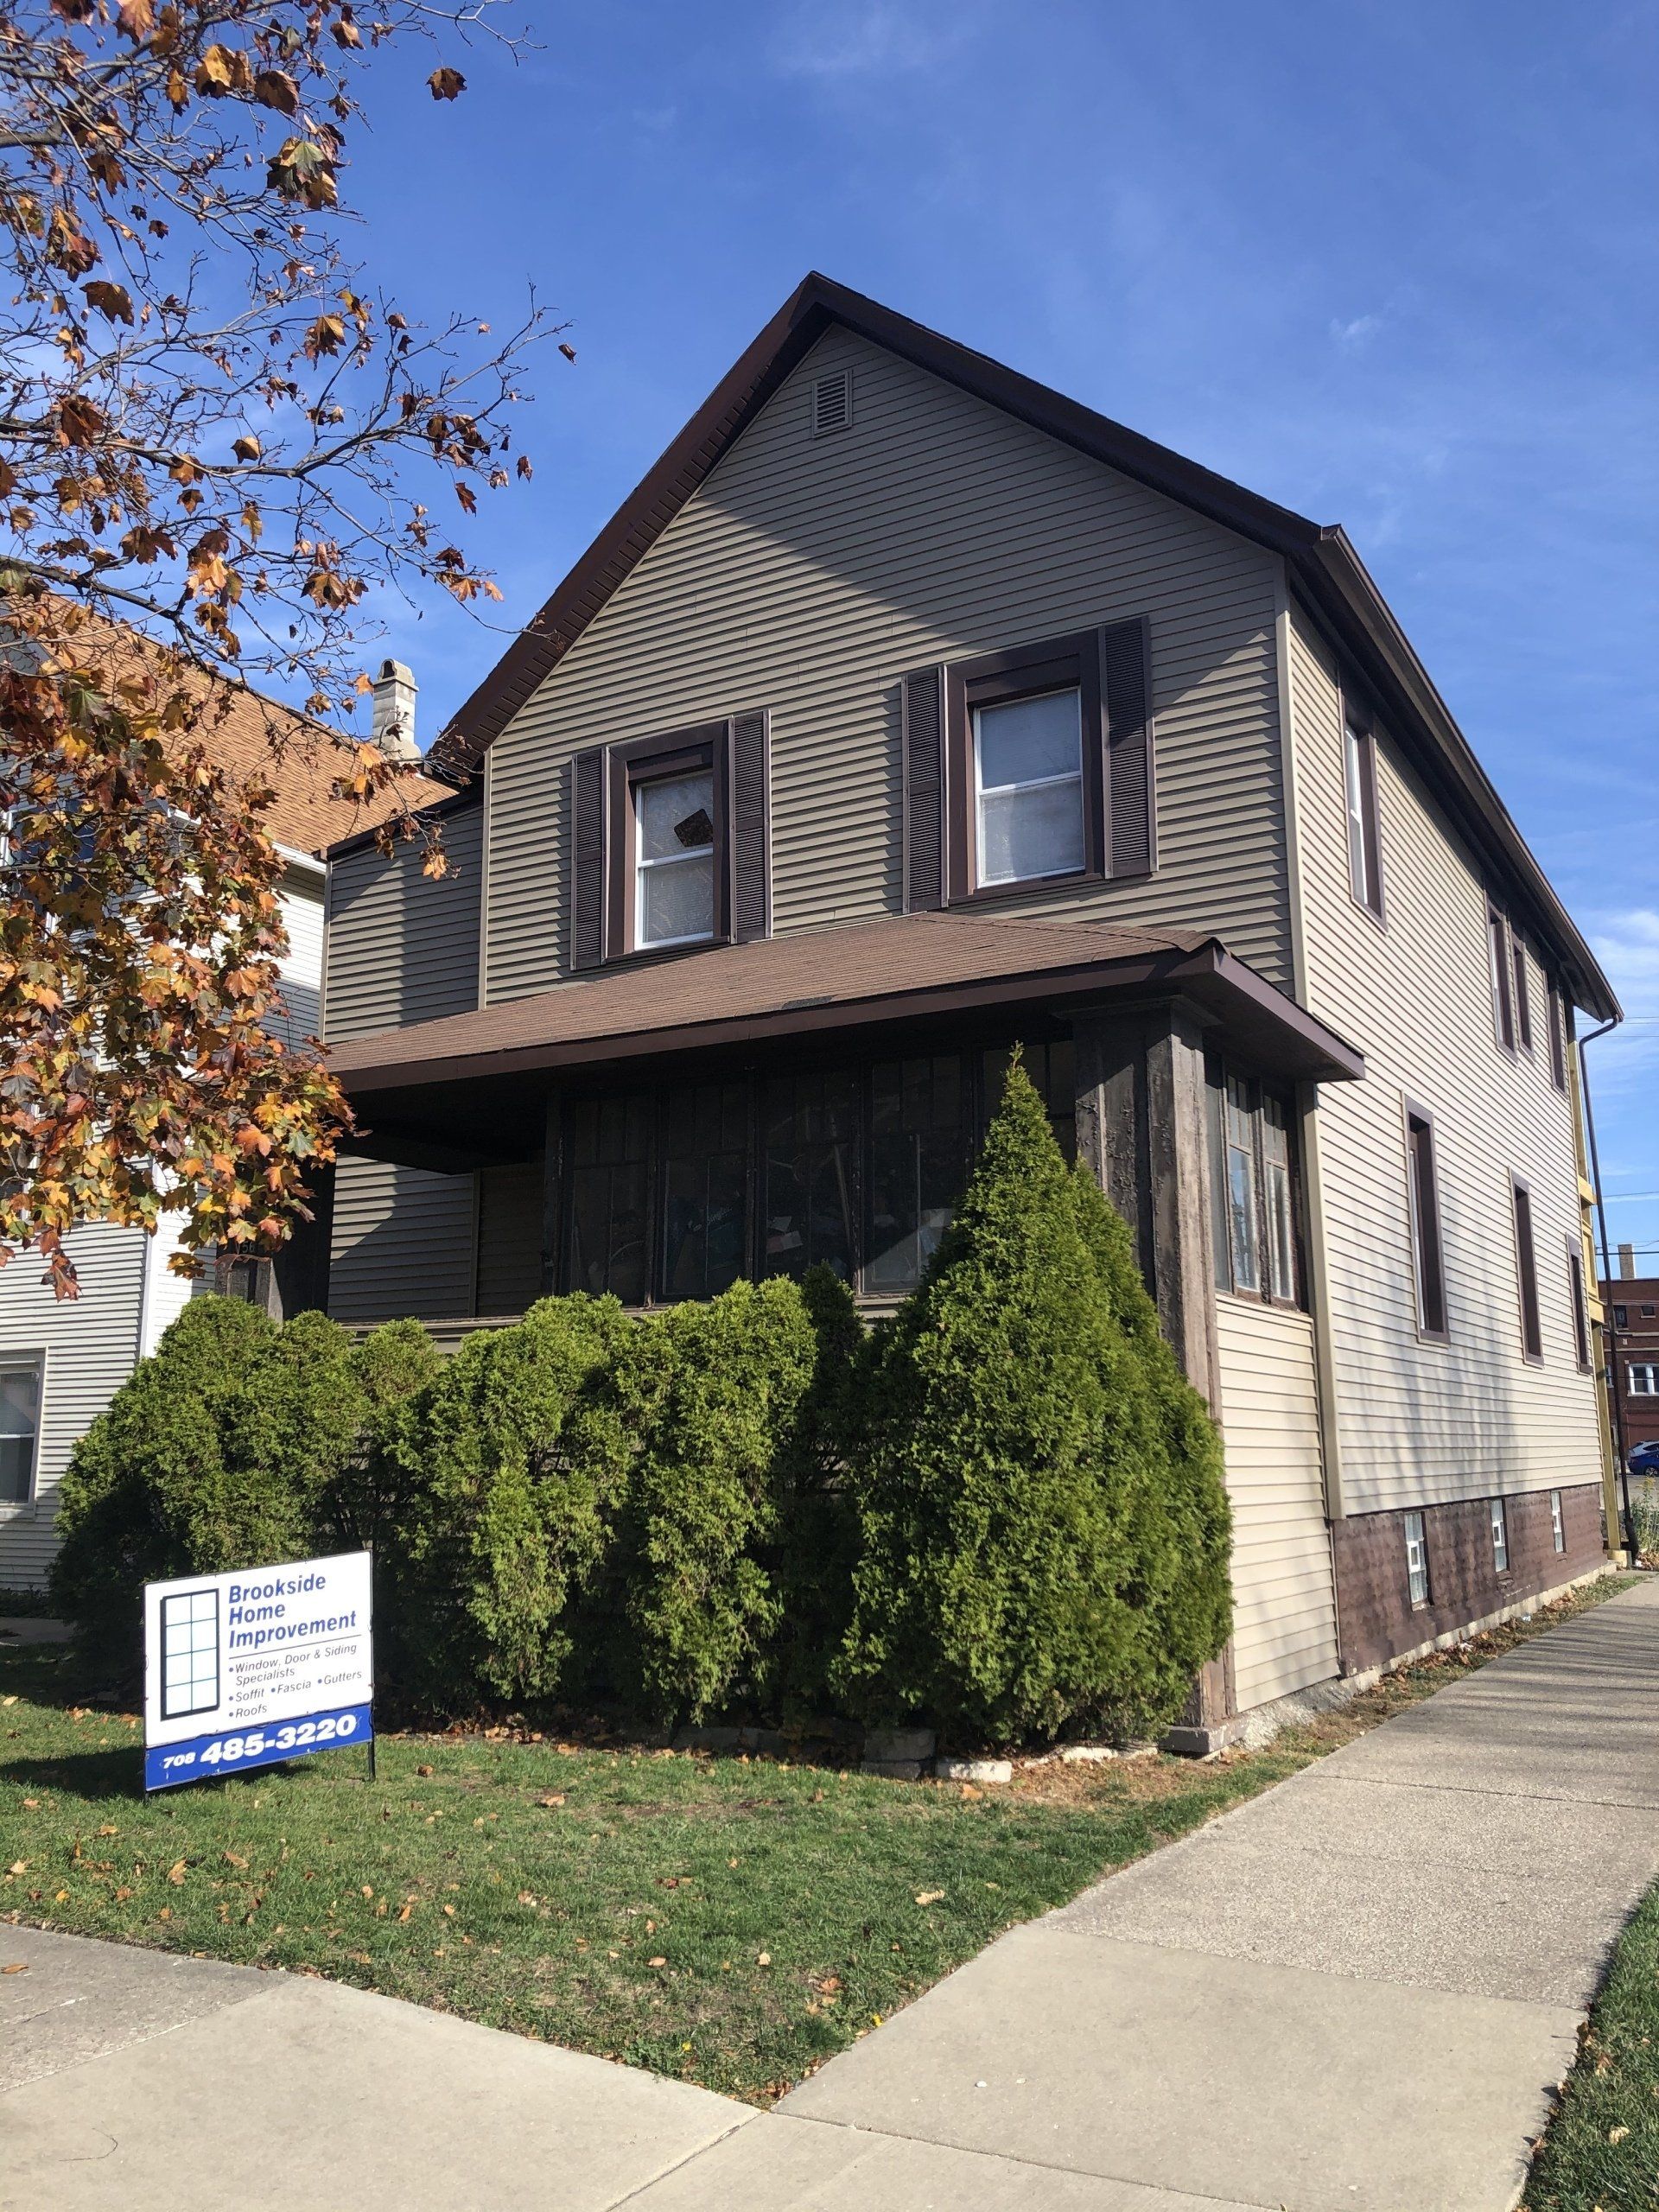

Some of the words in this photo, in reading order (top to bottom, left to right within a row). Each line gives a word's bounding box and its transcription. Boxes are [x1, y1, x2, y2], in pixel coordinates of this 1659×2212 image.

[229, 1573, 326, 1604] Brookside
[229, 1601, 285, 1625] Home
[229, 1611, 357, 1649] Improvement
[236, 1658, 281, 1674] Window,
[285, 1652, 310, 1665] Door
[315, 1650, 321, 1659] &
[325, 1644, 357, 1658] Siding
[236, 1669, 295, 1687] Specialists
[236, 1688, 264, 1702] Soffit
[277, 1681, 311, 1694] Fascia
[324, 1670, 362, 1686] Gutters
[236, 1705, 267, 1719] Roofs
[163, 1752, 195, 1769] 708
[200, 1714, 358, 1764] 485-3220
